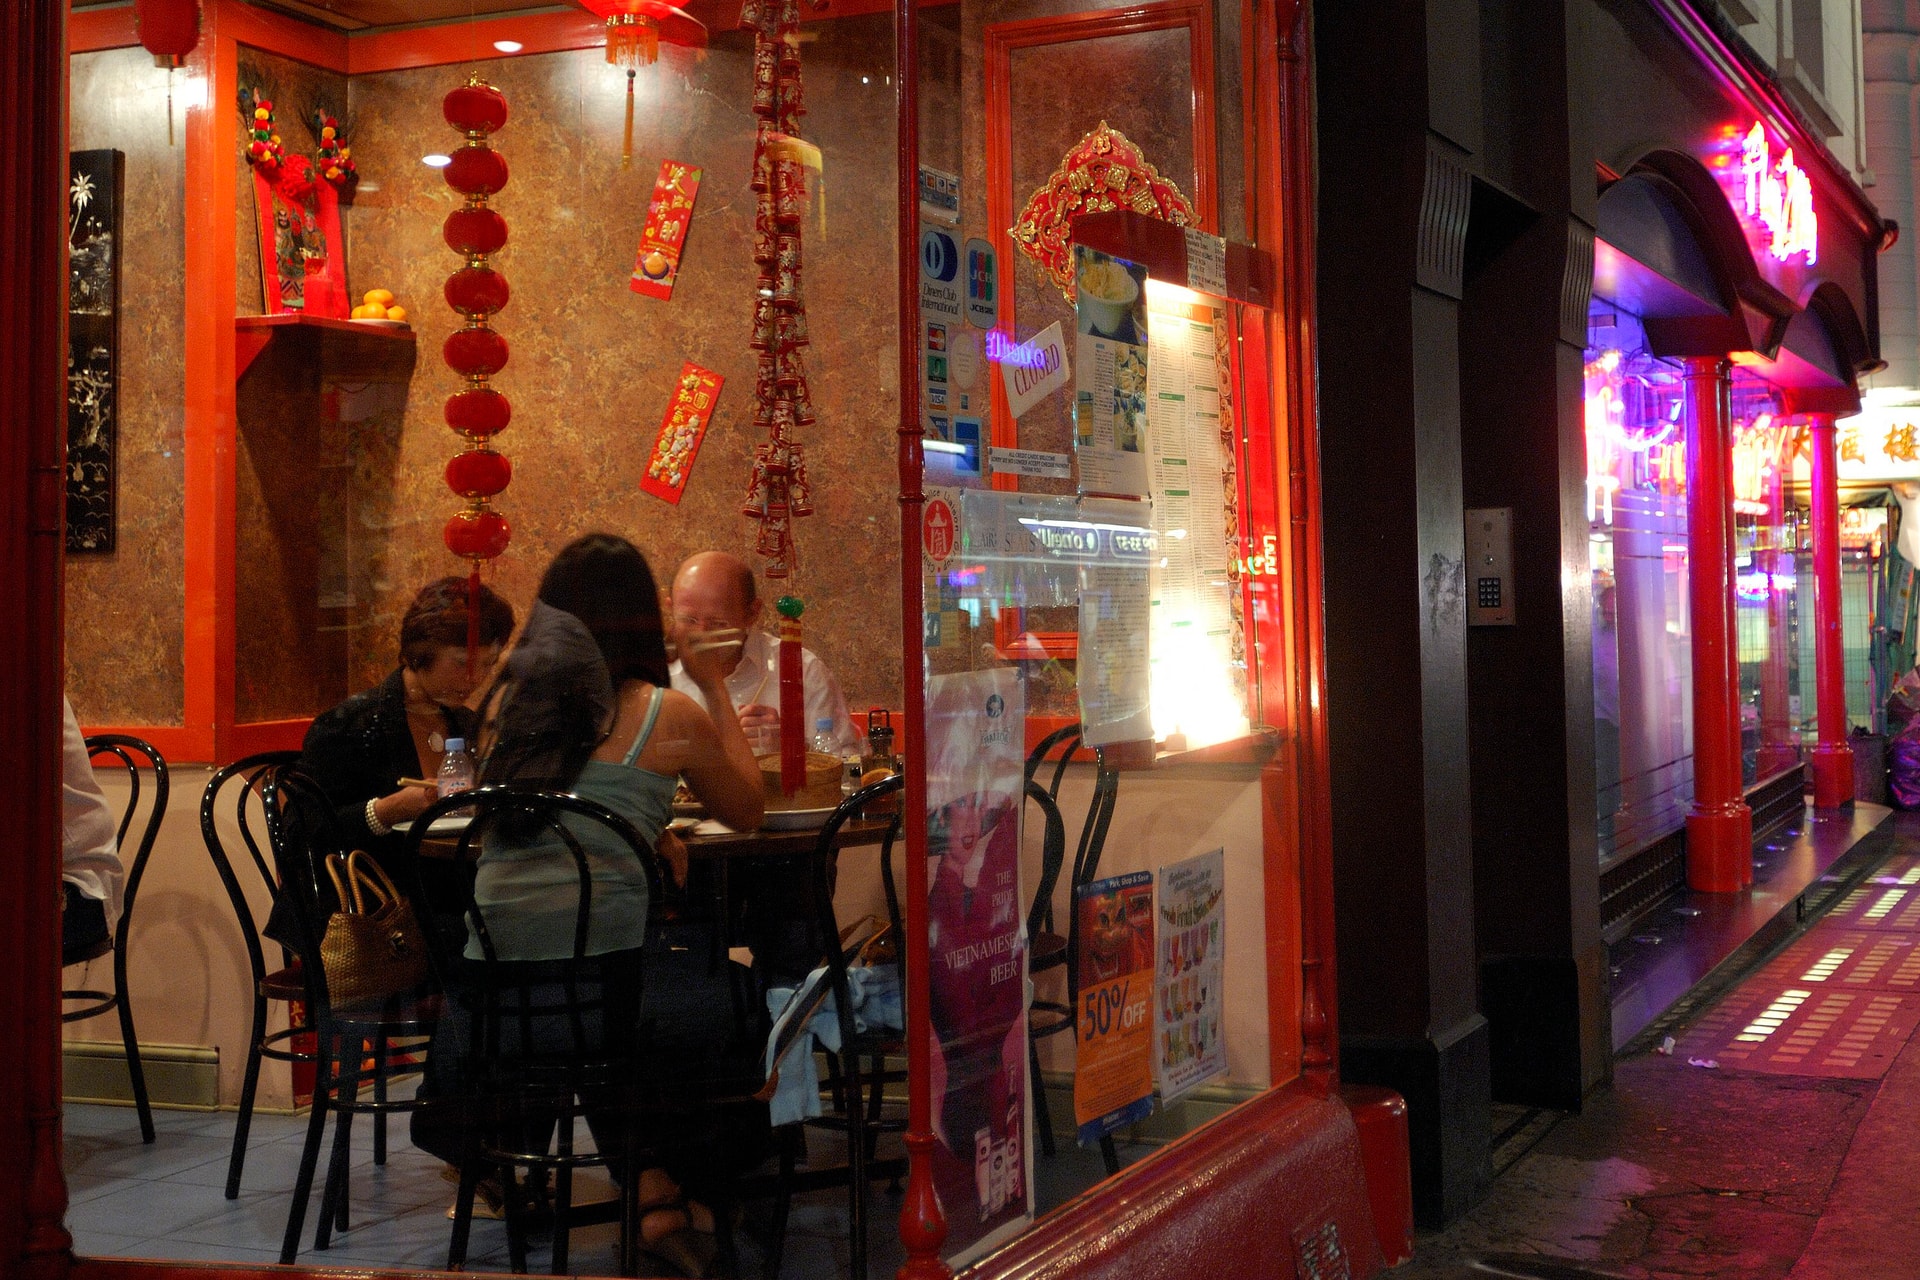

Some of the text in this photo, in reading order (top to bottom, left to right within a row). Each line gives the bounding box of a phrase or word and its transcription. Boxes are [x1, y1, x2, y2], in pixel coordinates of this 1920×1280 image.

[923, 283, 957, 301] Diners Club
[921, 296, 960, 315] International
[1014, 343, 1060, 396] CLOSED
[995, 870, 1012, 886] THE
[991, 888, 1014, 907] PRIDE
[945, 931, 1017, 970] VIETNAMESE
[990, 960, 1017, 986] BEER
[1085, 979, 1146, 1041] 50% OFF
